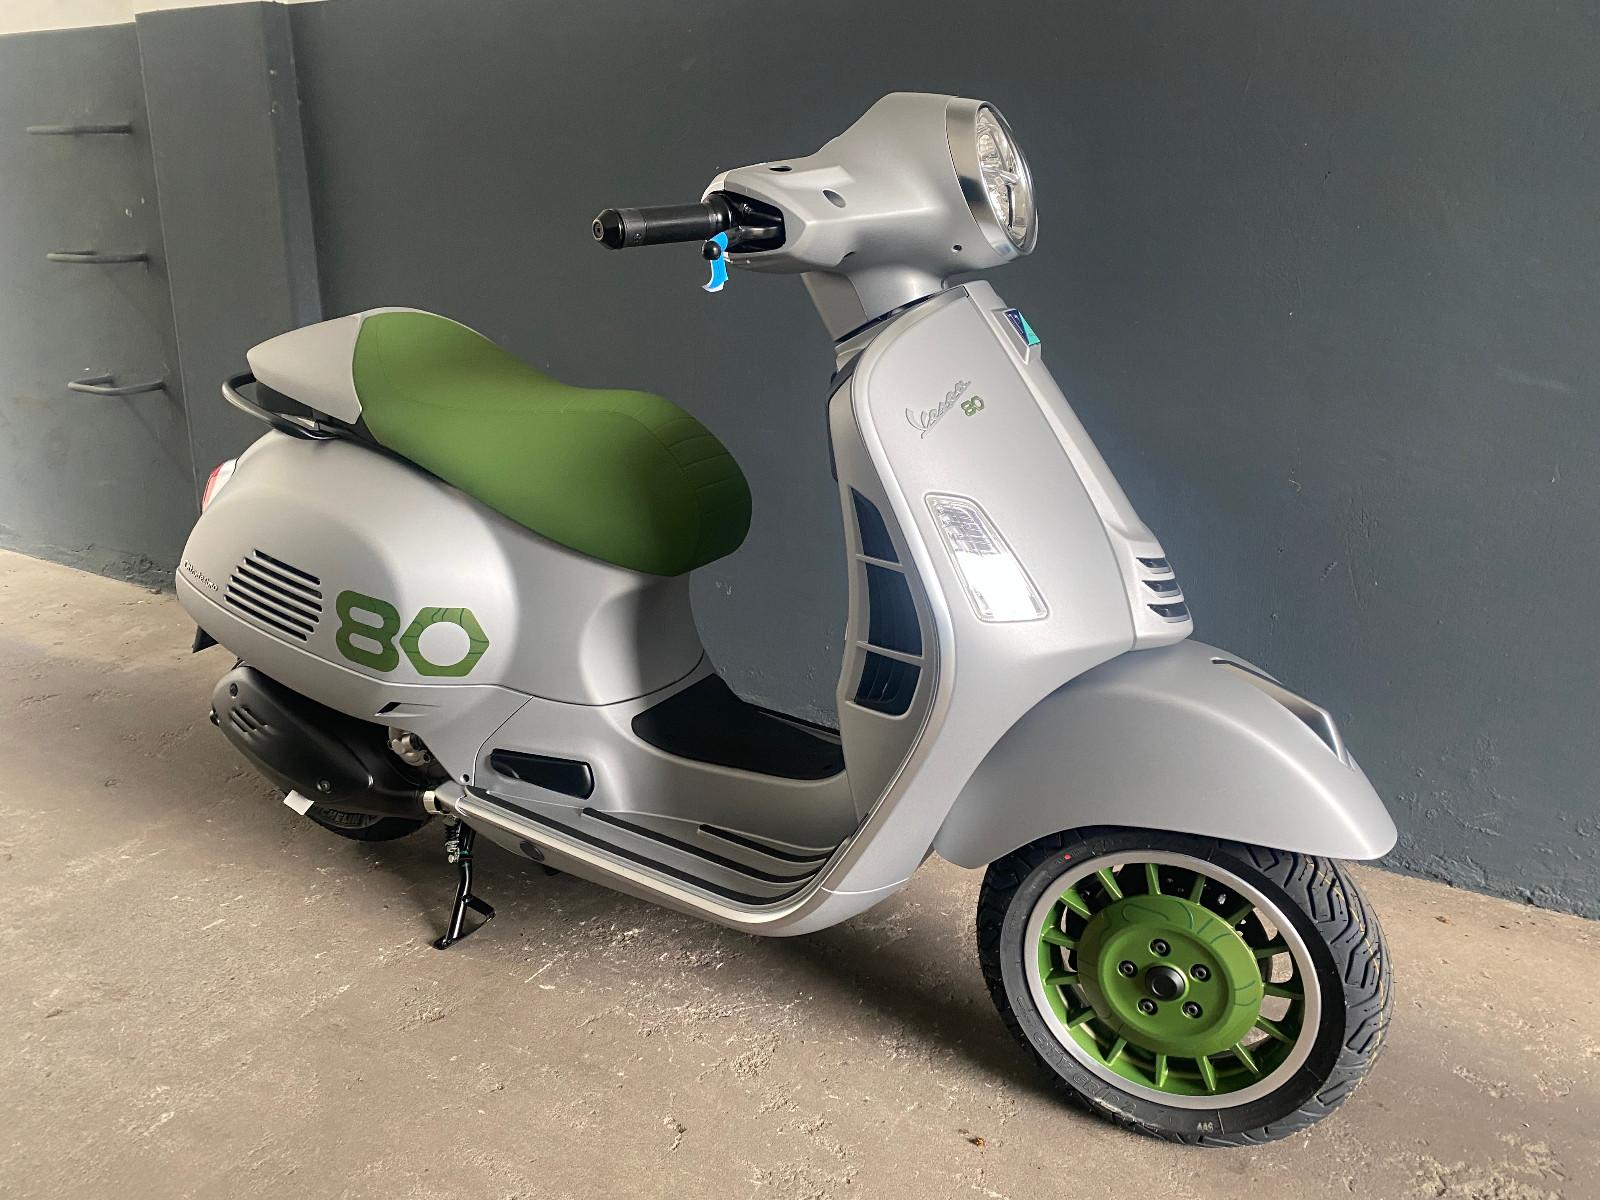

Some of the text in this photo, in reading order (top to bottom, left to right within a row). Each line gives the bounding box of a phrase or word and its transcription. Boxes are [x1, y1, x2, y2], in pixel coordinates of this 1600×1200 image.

[905, 380, 985, 439] Vespa 80
[336, 590, 490, 677] 80
[1072, 1073, 1120, 1104] GRIP
